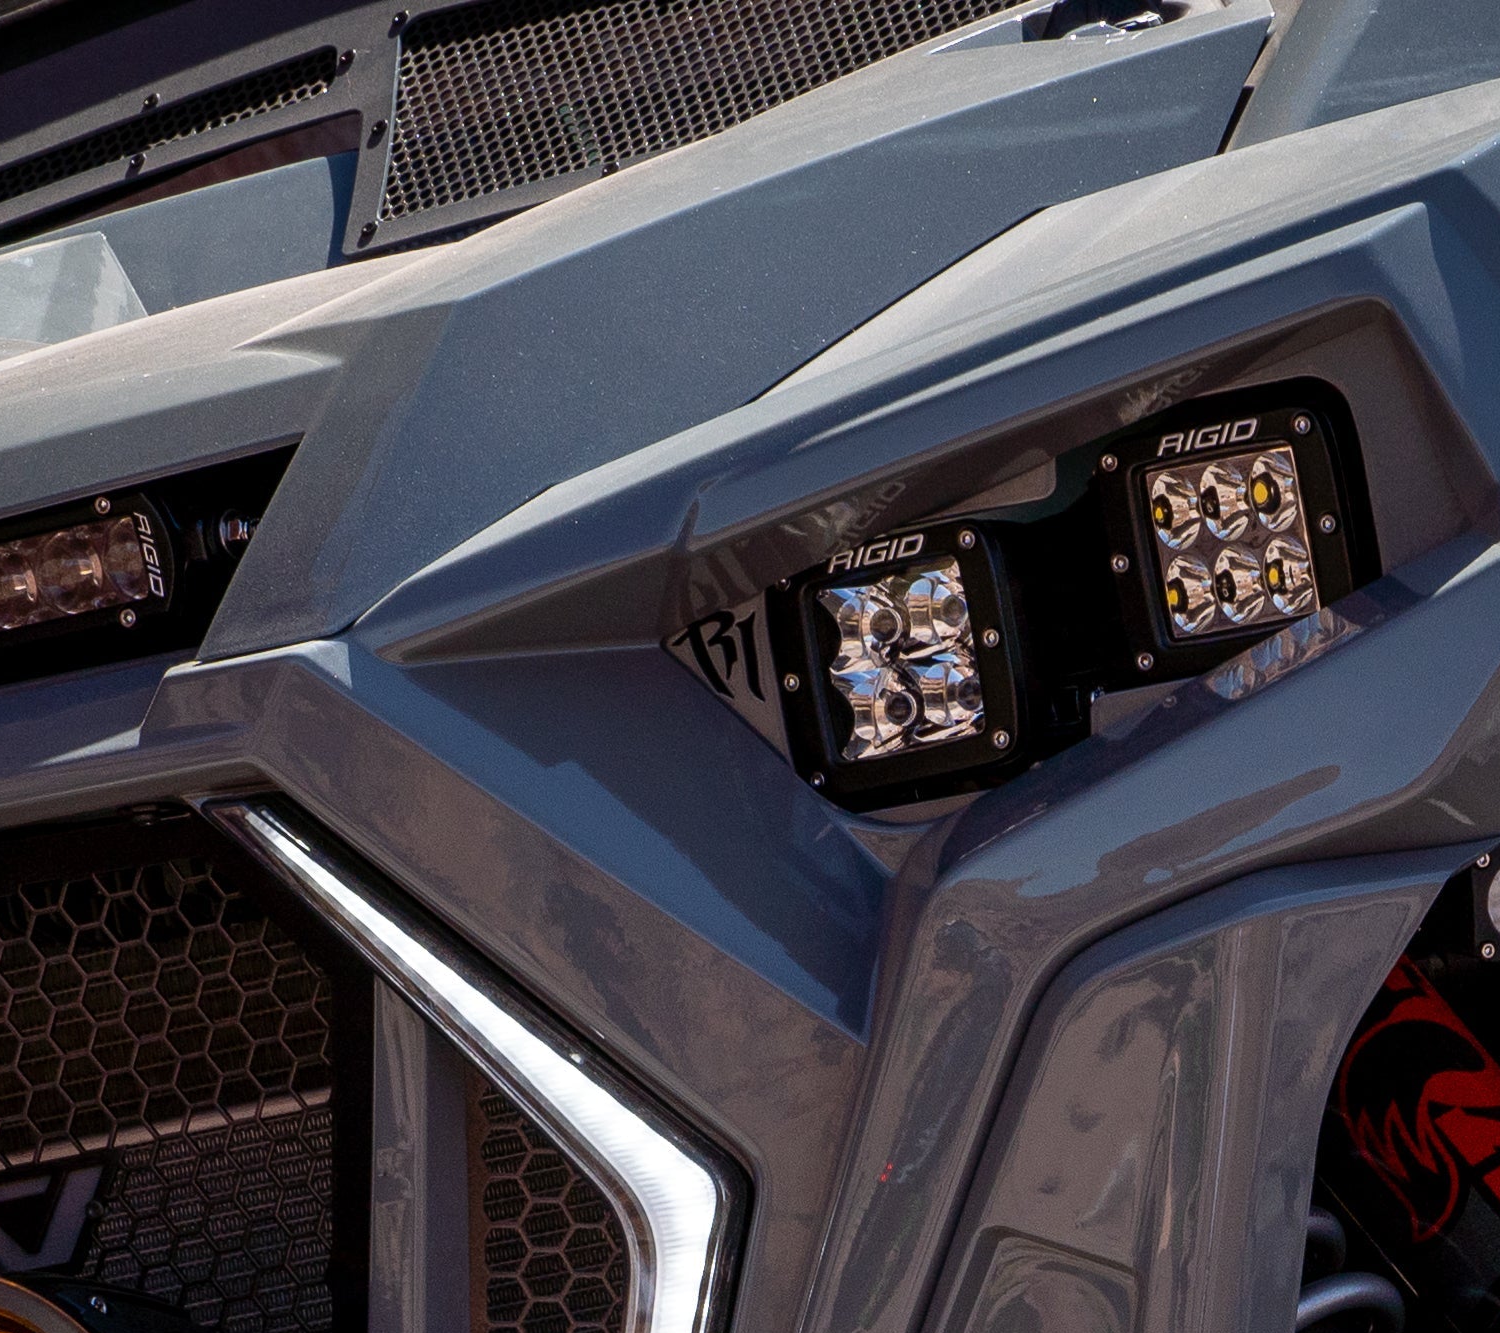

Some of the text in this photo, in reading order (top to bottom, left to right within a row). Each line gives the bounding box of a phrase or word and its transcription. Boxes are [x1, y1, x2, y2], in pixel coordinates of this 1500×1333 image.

[1156, 416, 1259, 458] RIGID
[133, 511, 165, 598] RIGID
[828, 532, 926, 575] RIGID
